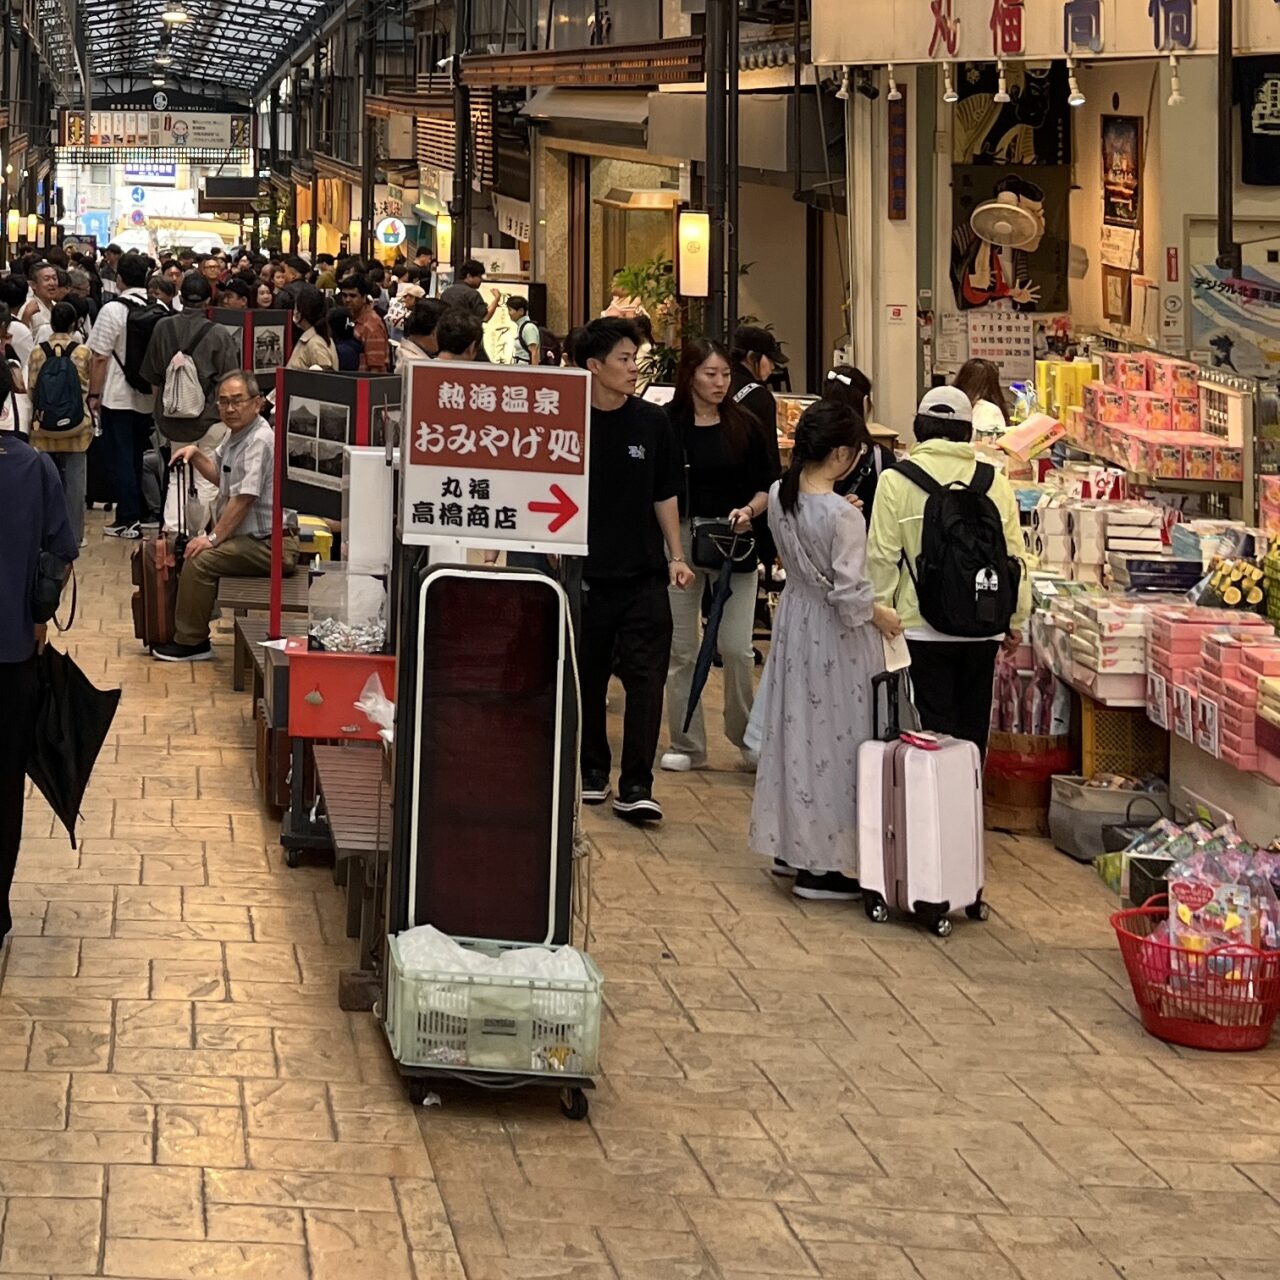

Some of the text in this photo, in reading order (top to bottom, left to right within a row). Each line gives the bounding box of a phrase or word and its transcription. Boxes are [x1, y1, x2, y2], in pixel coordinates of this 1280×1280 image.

[438, 381, 560, 416] 熱海温泉
[415, 421, 581, 463] おみやげ処
[441, 476, 490, 500] 丸福
[412, 501, 518, 530] 高橋商店
